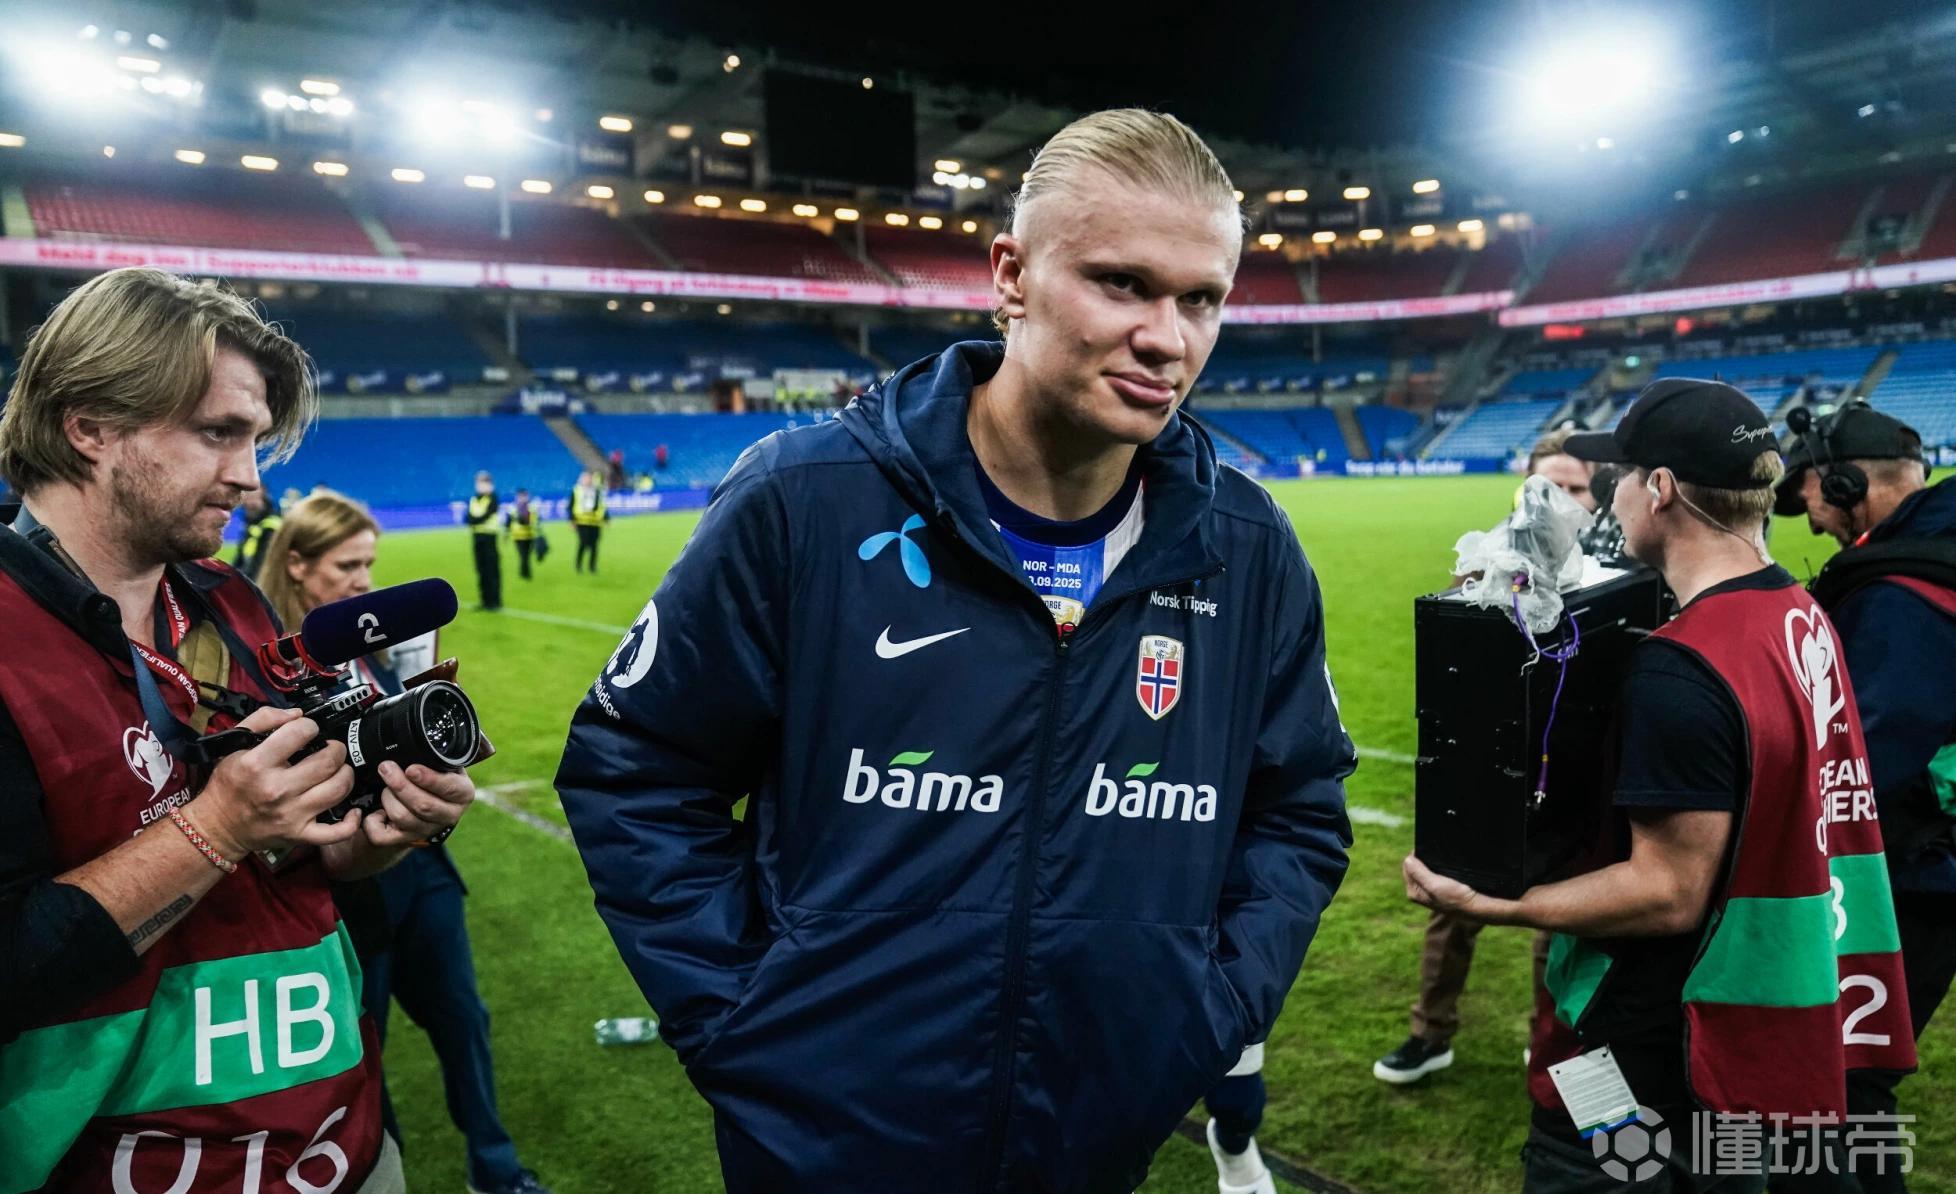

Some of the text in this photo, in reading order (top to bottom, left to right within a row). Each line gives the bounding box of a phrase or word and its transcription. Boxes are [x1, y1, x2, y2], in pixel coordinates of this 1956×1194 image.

[1023, 560, 1047, 572] NOR
[1057, 563, 1080, 574] MDA
[1043, 600, 1061, 610] ORGE
[1150, 591, 1180, 610] Norsk
[357, 612, 388, 644] 2
[842, 747, 1218, 822] bama bama
[195, 972, 335, 1086] HB
